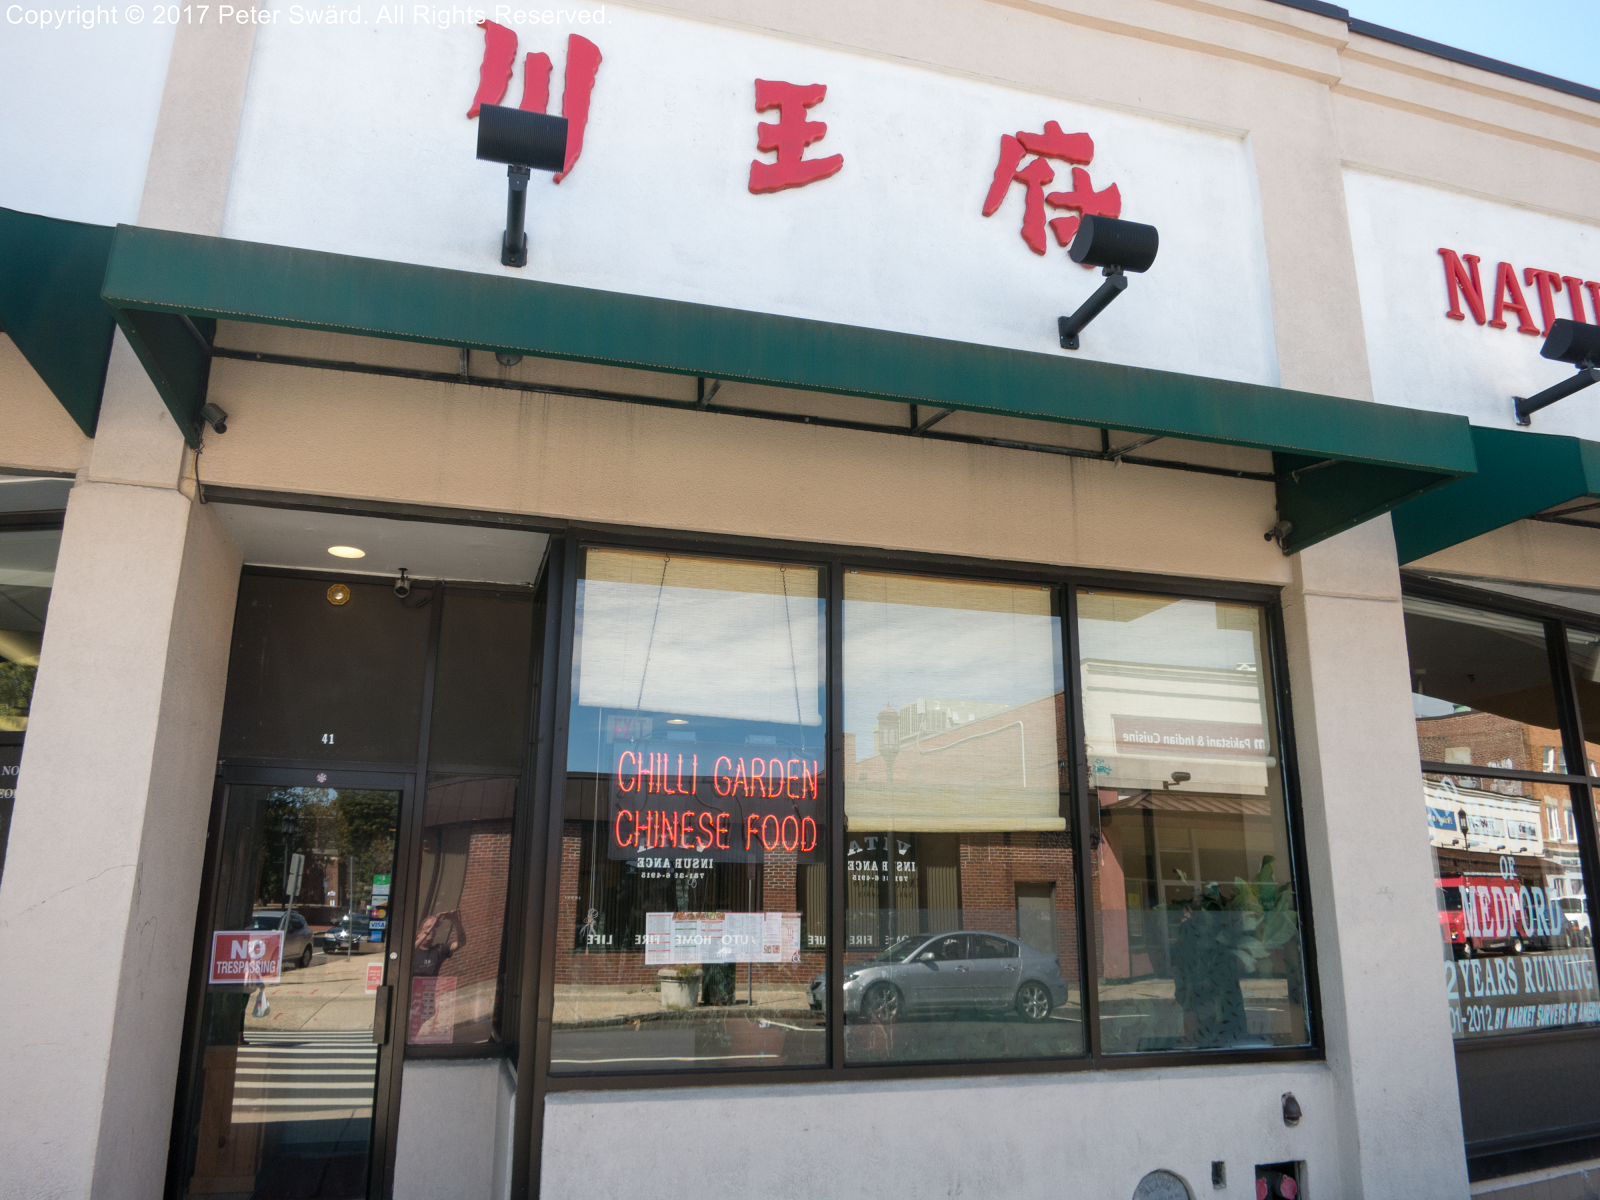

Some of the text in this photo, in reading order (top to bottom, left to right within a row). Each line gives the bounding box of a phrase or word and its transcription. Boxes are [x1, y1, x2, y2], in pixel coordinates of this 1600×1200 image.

[321, 733, 335, 745] 41
[618, 751, 818, 800] CHILLI GARDEN
[615, 809, 817, 851] CHINESE FOOD
[1499, 855, 1516, 880] OF
[1459, 884, 1562, 938] MEDFORD
[230, 939, 266, 960] NO
[216, 961, 277, 975] TRESPASSING
[1458, 956, 1518, 998] YEARS
[1521, 954, 1594, 994] RUNNING
[1494, 1007, 1507, 1030] BY
[1506, 1005, 1537, 1029] MARKET
[1536, 1003, 1568, 1027] SURVEYS
[1567, 1001, 1578, 1024] OF
